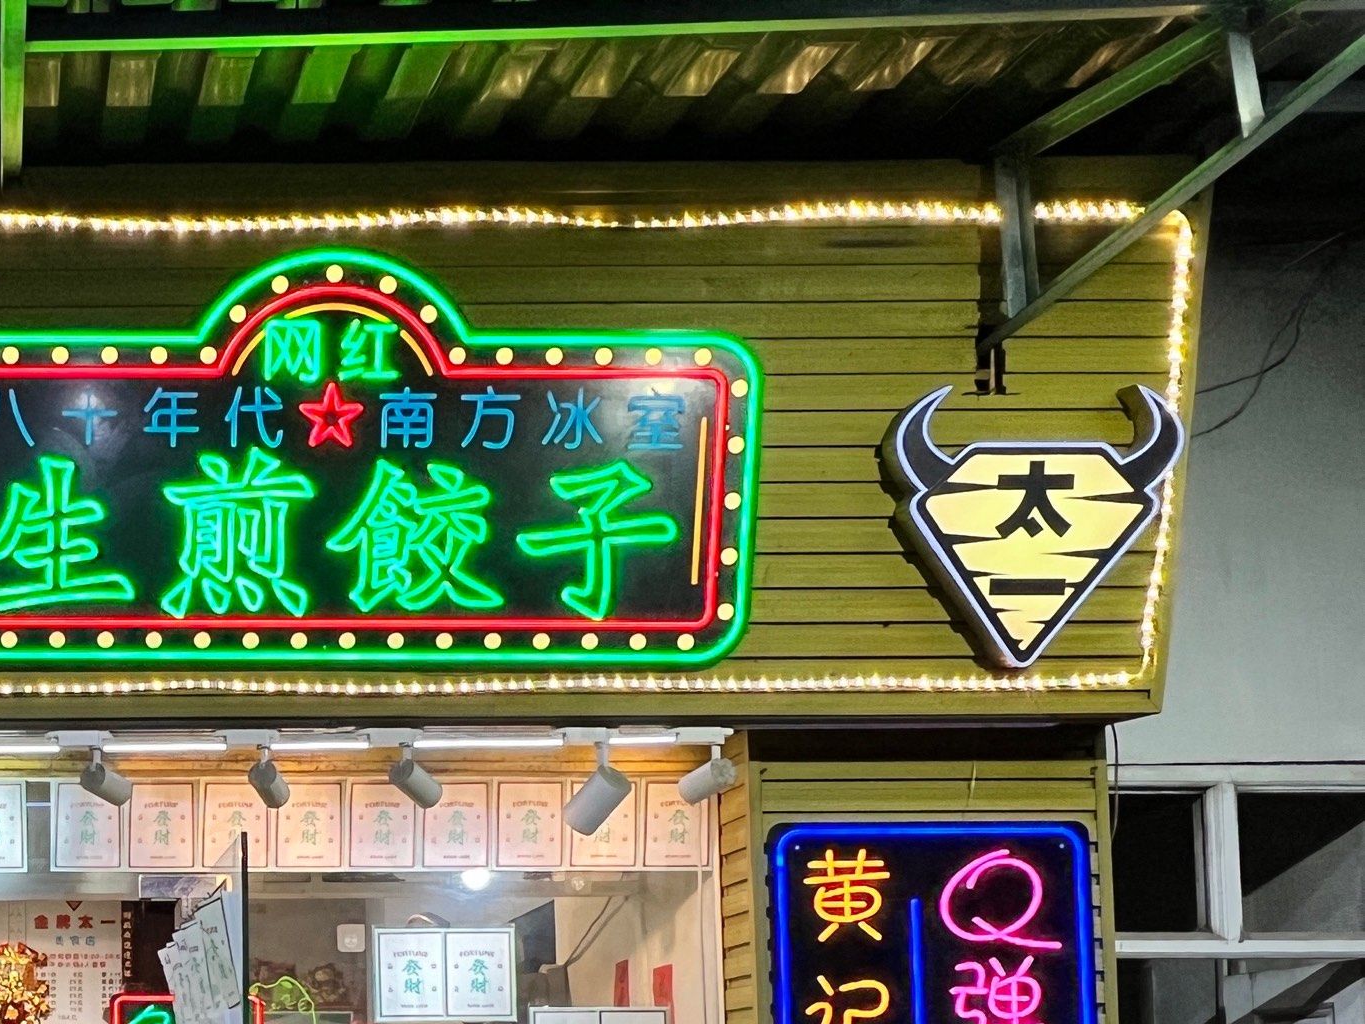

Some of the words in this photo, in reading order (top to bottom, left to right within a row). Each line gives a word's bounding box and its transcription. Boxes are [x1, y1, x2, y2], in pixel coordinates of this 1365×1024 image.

[262, 318, 401, 384] 网红
[379, 386, 687, 450] 南方冰室
[987, 460, 1075, 596] 太一
[402, 958, 423, 995] 發財
[469, 958, 489, 994] 發財
